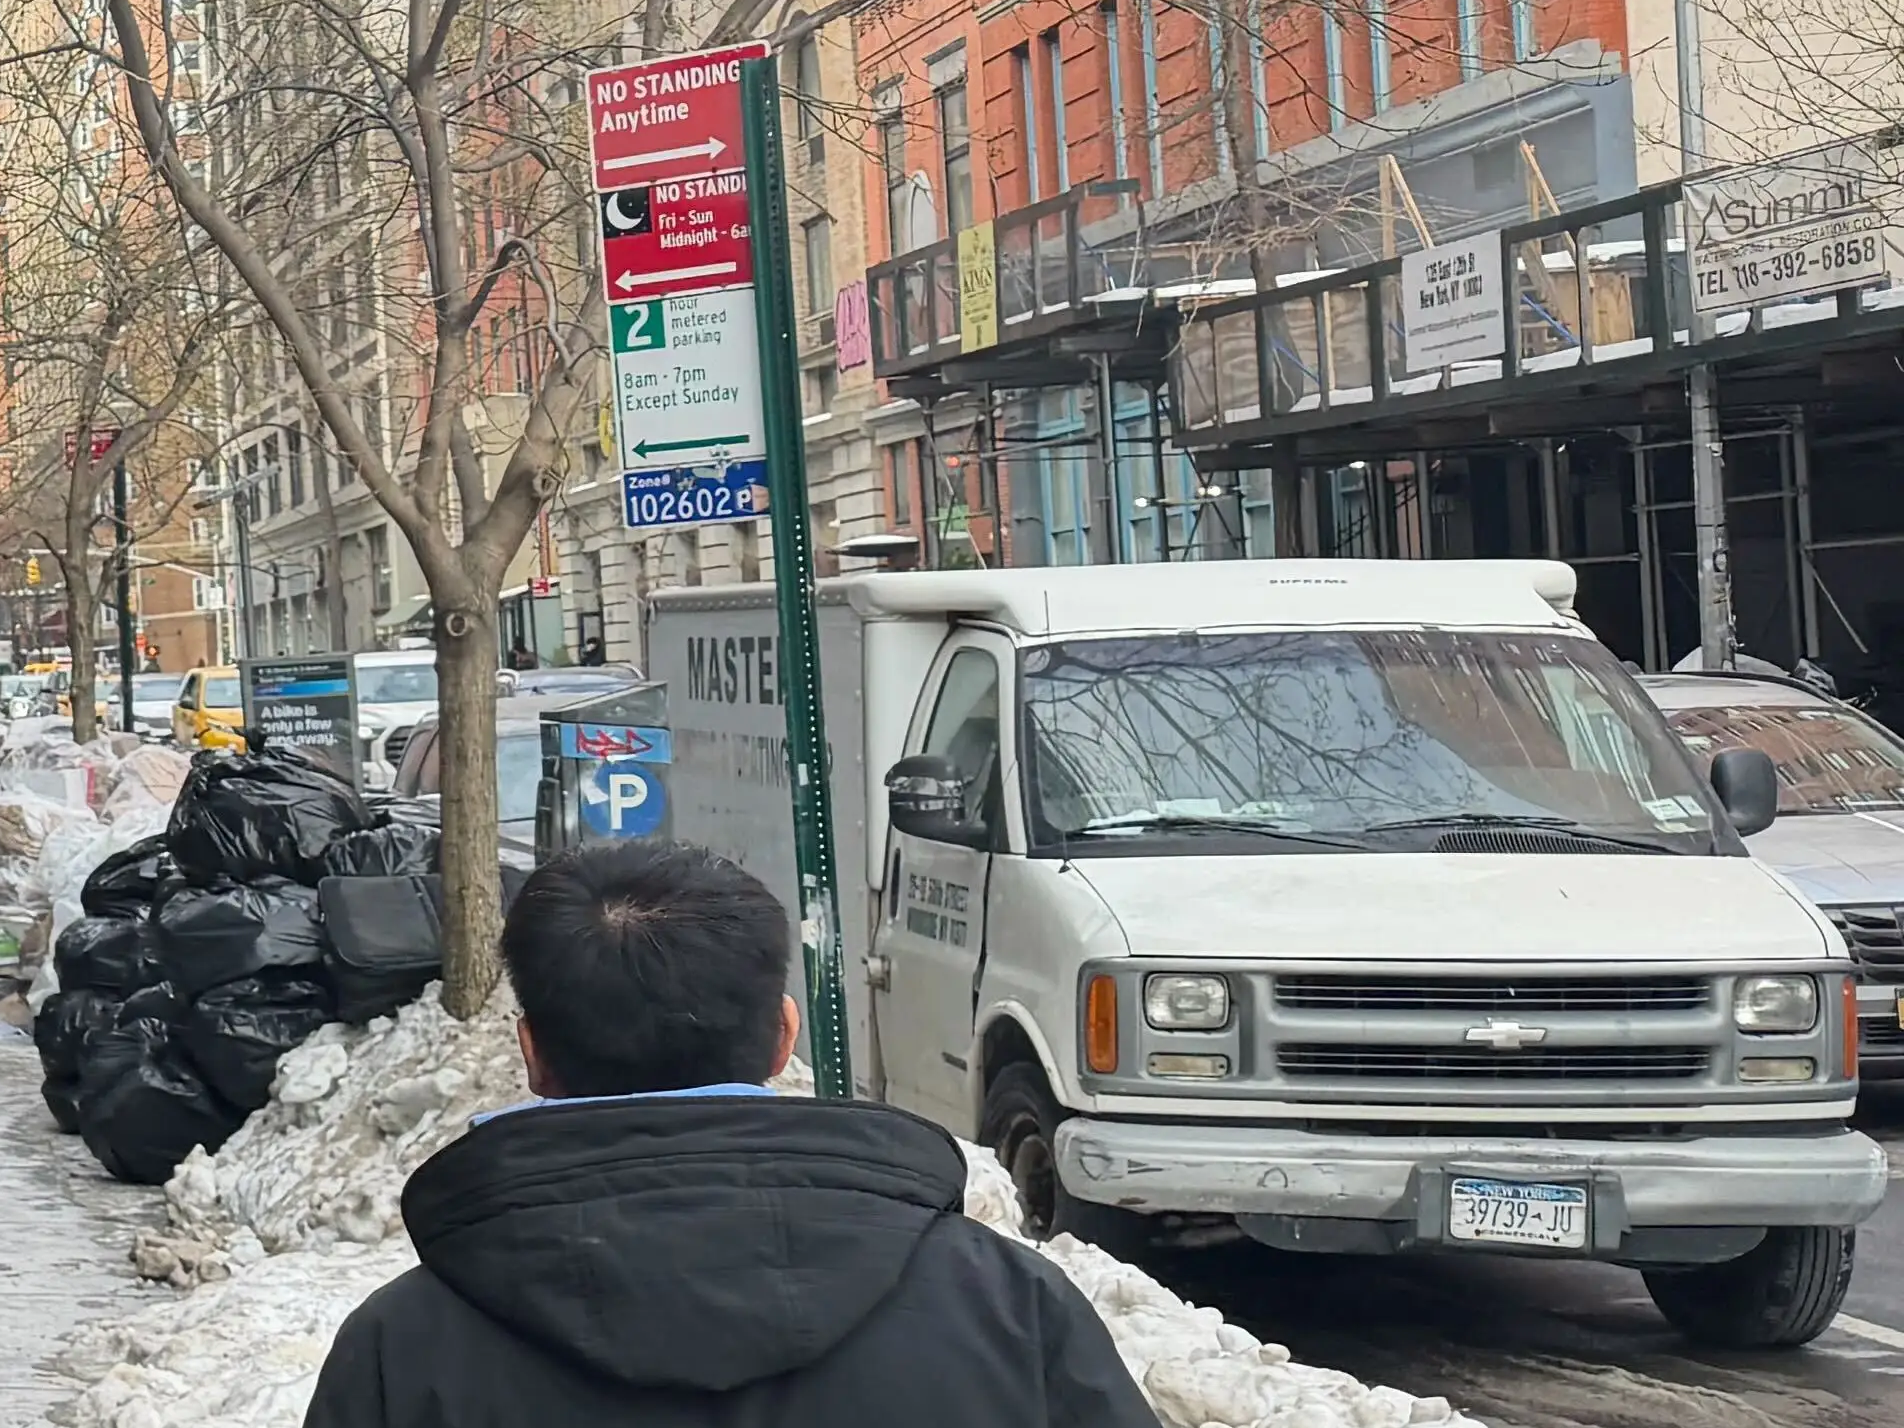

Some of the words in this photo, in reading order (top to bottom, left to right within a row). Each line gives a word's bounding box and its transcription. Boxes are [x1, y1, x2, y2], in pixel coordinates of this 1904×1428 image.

[597, 80, 628, 105] NO
[633, 59, 741, 99] STANDING
[600, 102, 689, 133] Anytime
[655, 184, 680, 204] NO
[686, 174, 747, 199] STANDI
[658, 213, 676, 230] Fri
[688, 210, 714, 225] Sun
[659, 227, 719, 249] Midnight
[1696, 269, 1730, 297] TEL
[625, 304, 652, 348] 2
[670, 297, 699, 312] hour
[671, 309, 727, 329] metered
[672, 329, 721, 349] parking
[623, 373, 658, 390] 8am
[673, 366, 706, 386] 7pm
[625, 390, 678, 412] Except
[683, 385, 739, 405] Sunday
[630, 486, 733, 523] 102602
[609, 773, 648, 830] P
